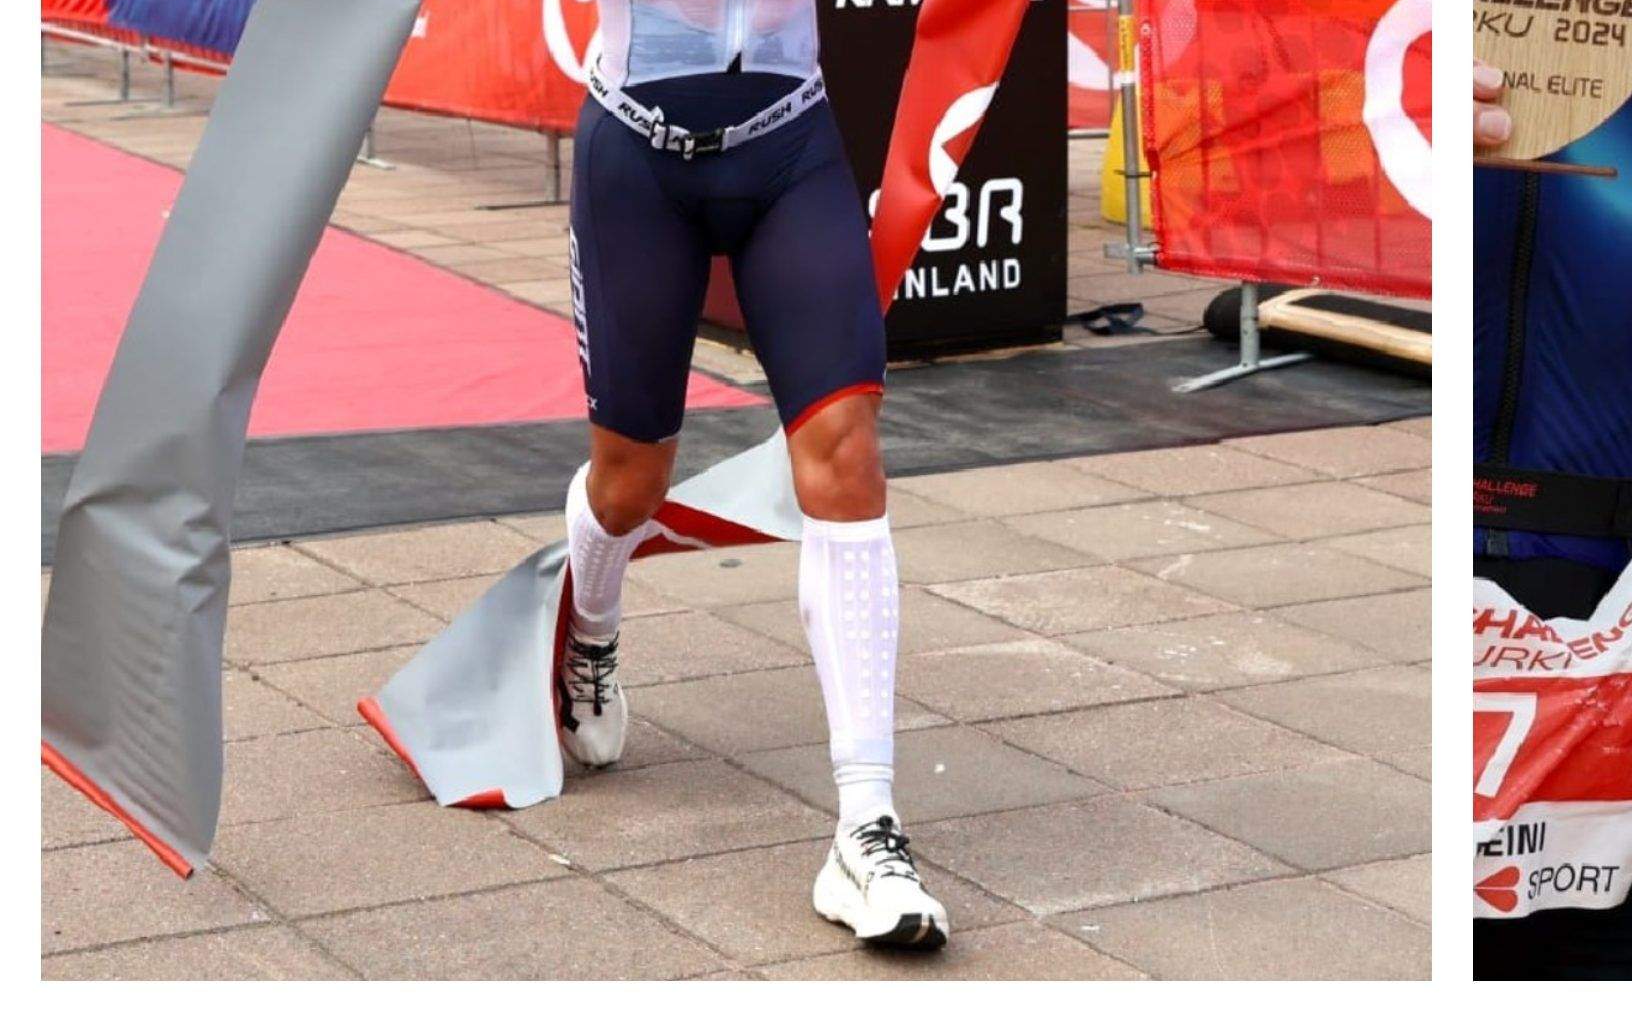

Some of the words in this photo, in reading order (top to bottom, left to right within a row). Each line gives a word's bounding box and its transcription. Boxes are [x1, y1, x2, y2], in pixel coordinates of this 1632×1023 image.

[1553, 17, 1627, 48] 2024
[1546, 74, 1604, 100] ELITE
[748, 101, 793, 136] RUSH
[1527, 864, 1620, 901] SPORT
